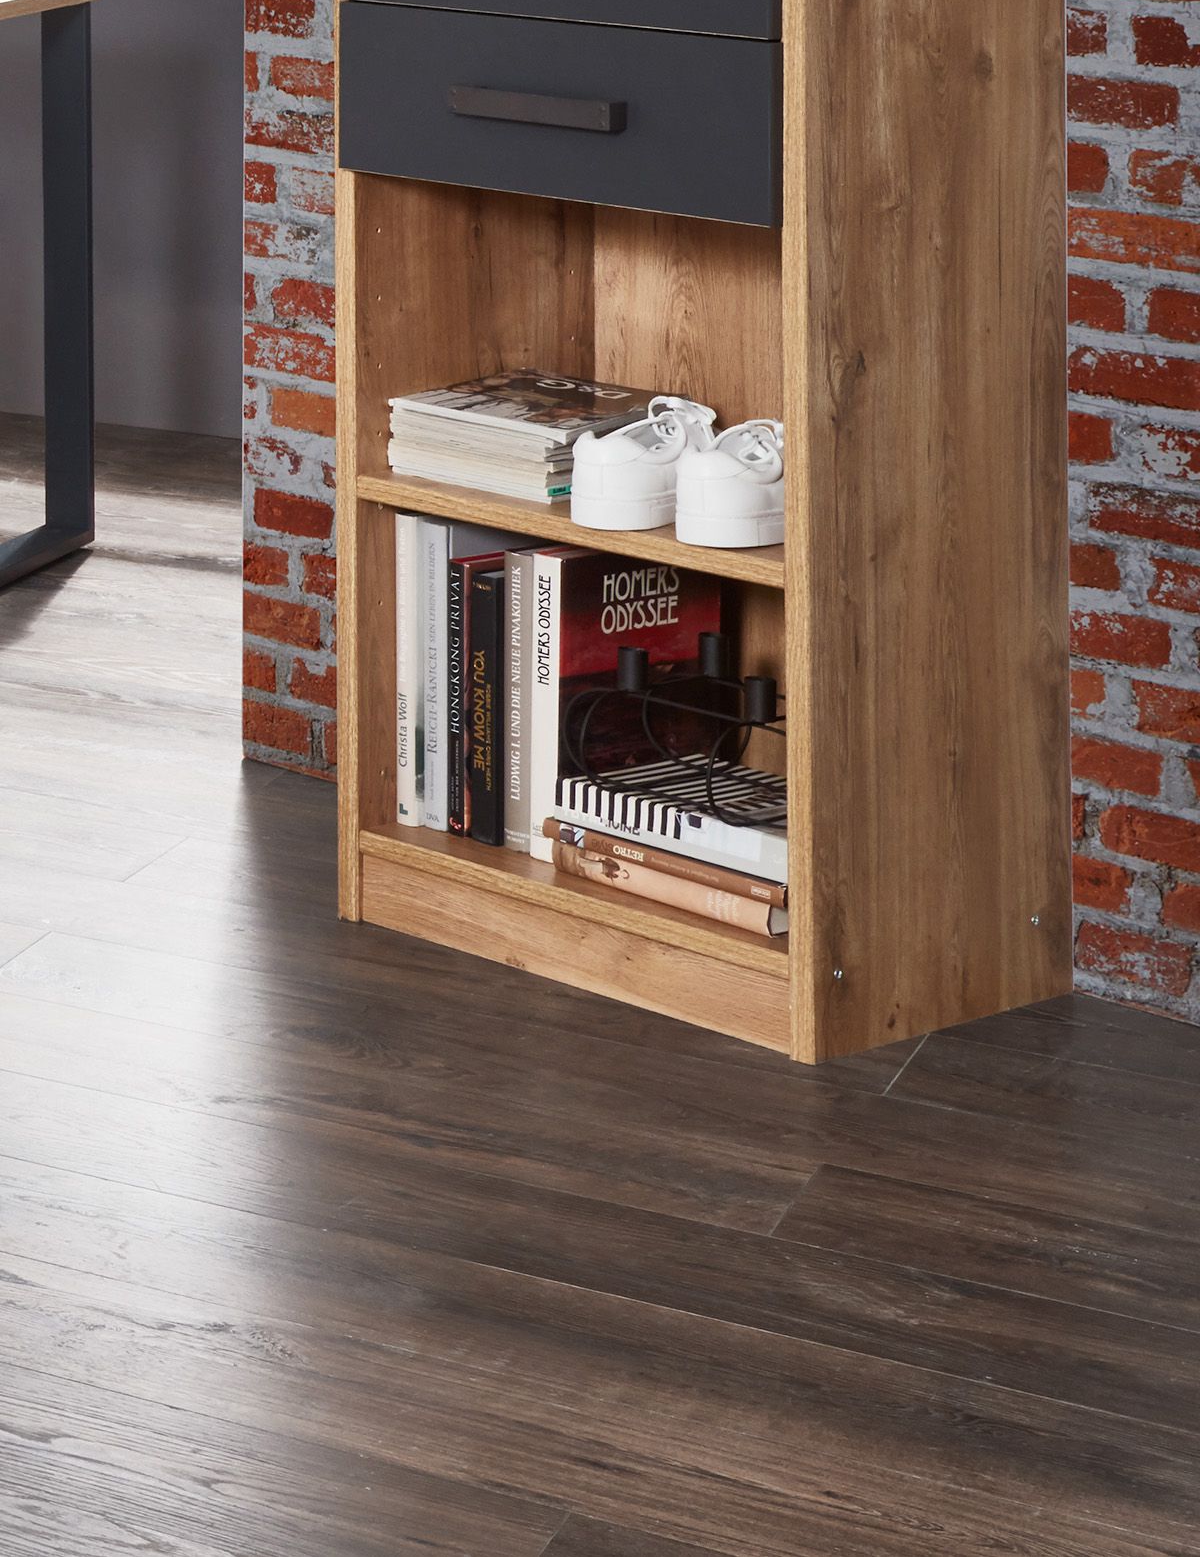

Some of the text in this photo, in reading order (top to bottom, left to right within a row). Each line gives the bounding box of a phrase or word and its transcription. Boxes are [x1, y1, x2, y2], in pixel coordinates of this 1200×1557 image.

[428, 541, 436, 580] BILDERN
[428, 581, 436, 592] IN
[603, 566, 680, 604] HOMERS
[428, 593, 436, 622] LEBEN
[601, 595, 679, 635] ODYSSEE
[428, 623, 436, 643] SEIN
[537, 574, 552, 686] HOMERS ODYSSEE
[450, 569, 461, 734] HONGKONG PRIVAT
[426, 645, 438, 755] REICH-RANICKI
[511, 566, 522, 801] LUDWIG I. UND DIE NEUE PINAKOTHEK
[398, 692, 408, 768] Christa Wolf
[473, 649, 485, 772] YOU KNOW ME
[612, 845, 644, 862] RETRO
